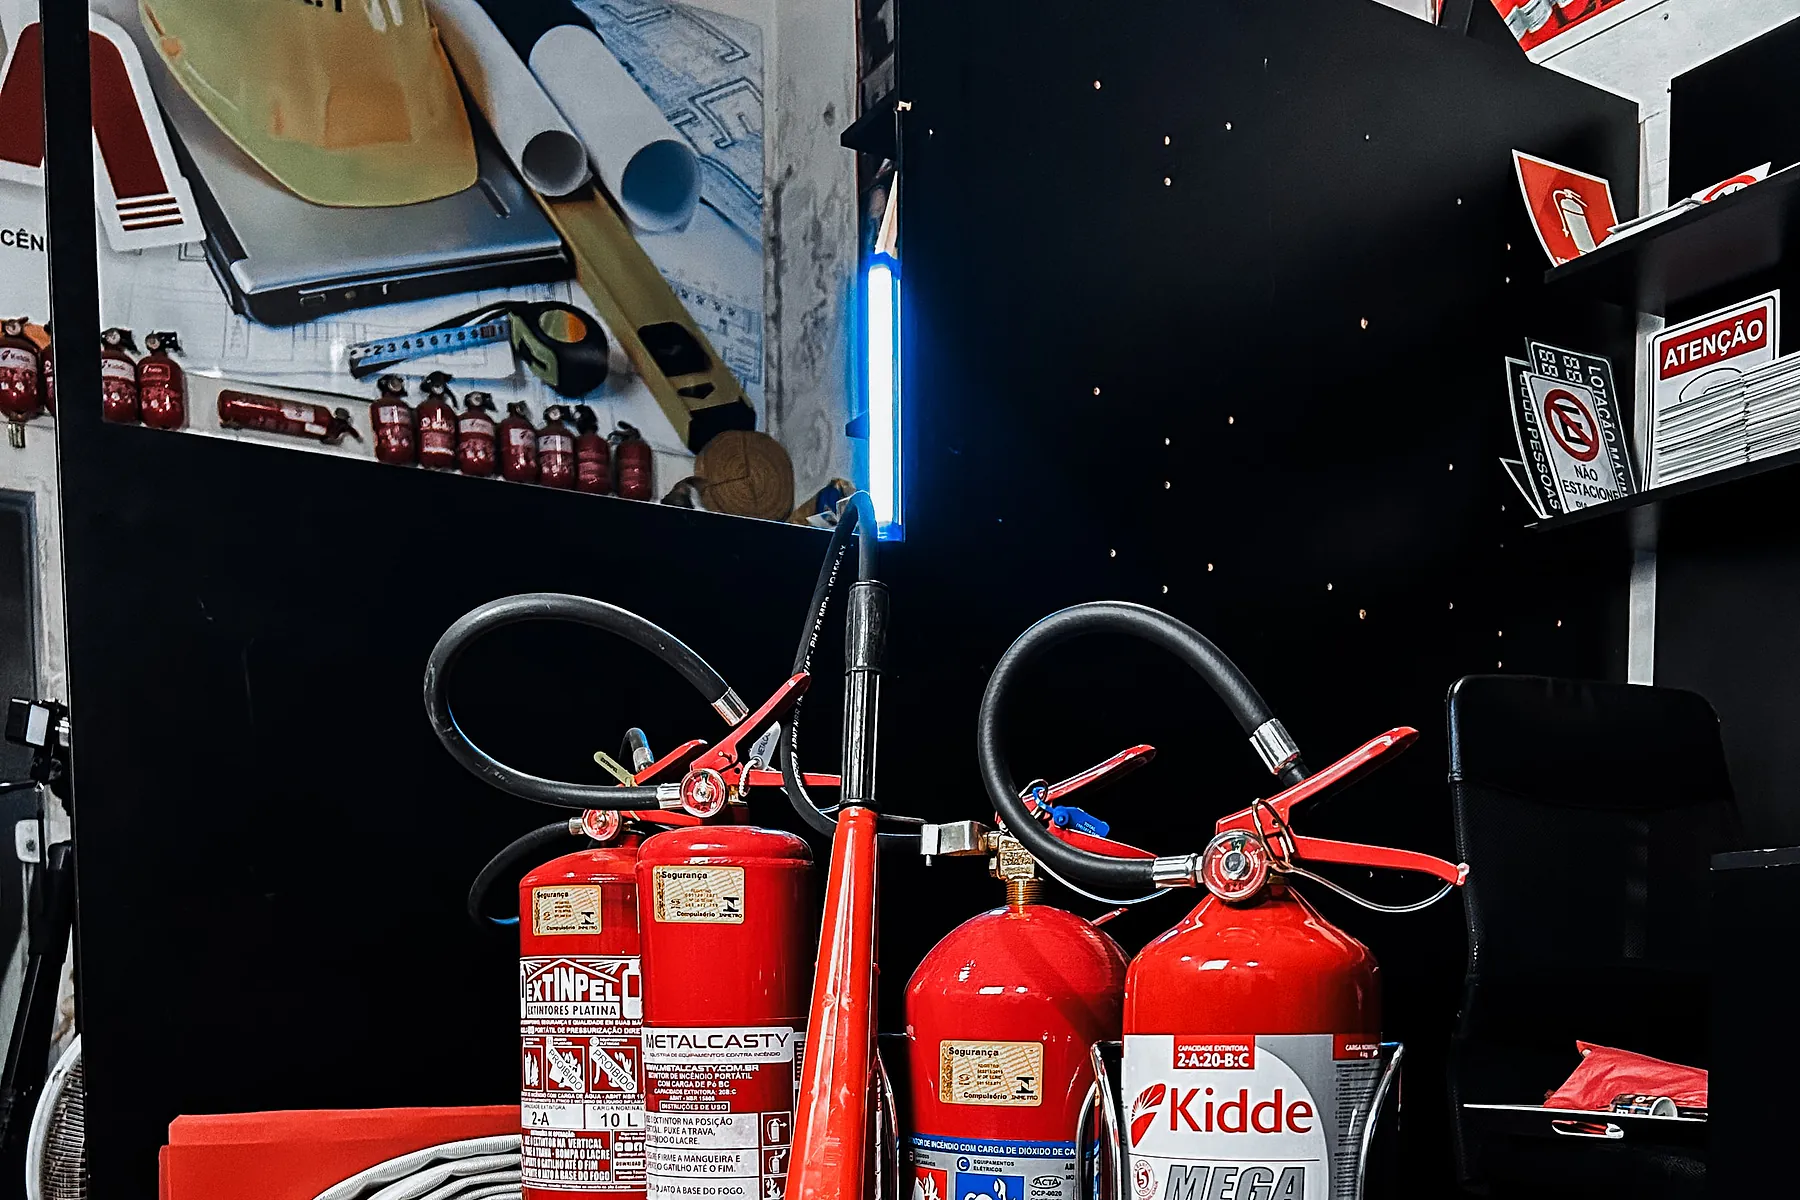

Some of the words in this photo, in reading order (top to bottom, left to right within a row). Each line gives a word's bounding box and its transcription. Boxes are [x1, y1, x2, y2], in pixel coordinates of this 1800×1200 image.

[388, 342, 396, 352] 3
[402, 341, 410, 350] 4
[416, 338, 424, 348] 5
[430, 335, 438, 345] 6
[1664, 319, 1763, 370] ATENÇÃO
[1527, 427, 1561, 510] PESSOAS
[1574, 464, 1599, 482] NÃO
[1562, 479, 1620, 500] ESTACIONE
[661, 870, 708, 881] Segurança
[537, 891, 569, 900] Segurança
[676, 910, 716, 918] Compulsório
[526, 967, 620, 1002] EXTINPEL
[527, 1005, 569, 1016] EXTINTORES
[573, 1005, 617, 1016] PLATINA
[566, 1027, 623, 1036] PRESSURIZAÇÃO
[645, 1033, 789, 1049] METALCASTY
[948, 1046, 999, 1058] Segurança
[1177, 1052, 1250, 1067] 2-A:20-B:C
[548, 1048, 583, 1090] PROIBIDO
[592, 1049, 635, 1091] PROIBIDO
[680, 1071, 713, 1080] INCÊNDIO
[715, 1071, 753, 1080] PORTÁTIL
[963, 1091, 1008, 1100] Compulsório
[1170, 1087, 1314, 1134] Kidde
[532, 1111, 550, 1126] 2-A
[600, 1112, 620, 1127] 10
[627, 1112, 638, 1127] L
[695, 1117, 733, 1127] POSIÇÃO
[664, 1126, 680, 1134] PUXE
[688, 1127, 716, 1136] TRAVA,
[568, 1138, 603, 1149] VERTICAL
[924, 1139, 931, 1147] DE
[931, 1140, 959, 1150] INCÊNDIO
[960, 1143, 976, 1152] COM
[977, 1145, 1004, 1153] CARGA
[1006, 1146, 1017, 1155] DE
[1018, 1144, 1051, 1156] DIÓXIDO
[1052, 1148, 1063, 1156] DE
[555, 1148, 579, 1159] ROMPA
[580, 1149, 586, 1159] O
[586, 1149, 611, 1160] LACRE
[683, 1155, 733, 1163] MANGUEIRA
[735, 1155, 741, 1163] E
[564, 1159, 577, 1170] ATÉ
[577, 1160, 583, 1170] O
[584, 1160, 598, 1171] FIM
[657, 1163, 662, 1171] O
[663, 1163, 692, 1172] GATILHO
[693, 1164, 708, 1172] ATÉ
[709, 1164, 716, 1172] O
[718, 1165, 736, 1173] FIM.
[560, 1169, 577, 1180] BASE
[578, 1170, 588, 1180] DO
[589, 1170, 610, 1181] FOGO
[1034, 1178, 1060, 1186] ACTA
[1164, 1164, 1306, 1200] MEGA
[660, 1185, 676, 1193] JATO
[682, 1186, 701, 1195] BASE
[702, 1187, 716, 1195] DO
[718, 1187, 745, 1195] FOGO.
